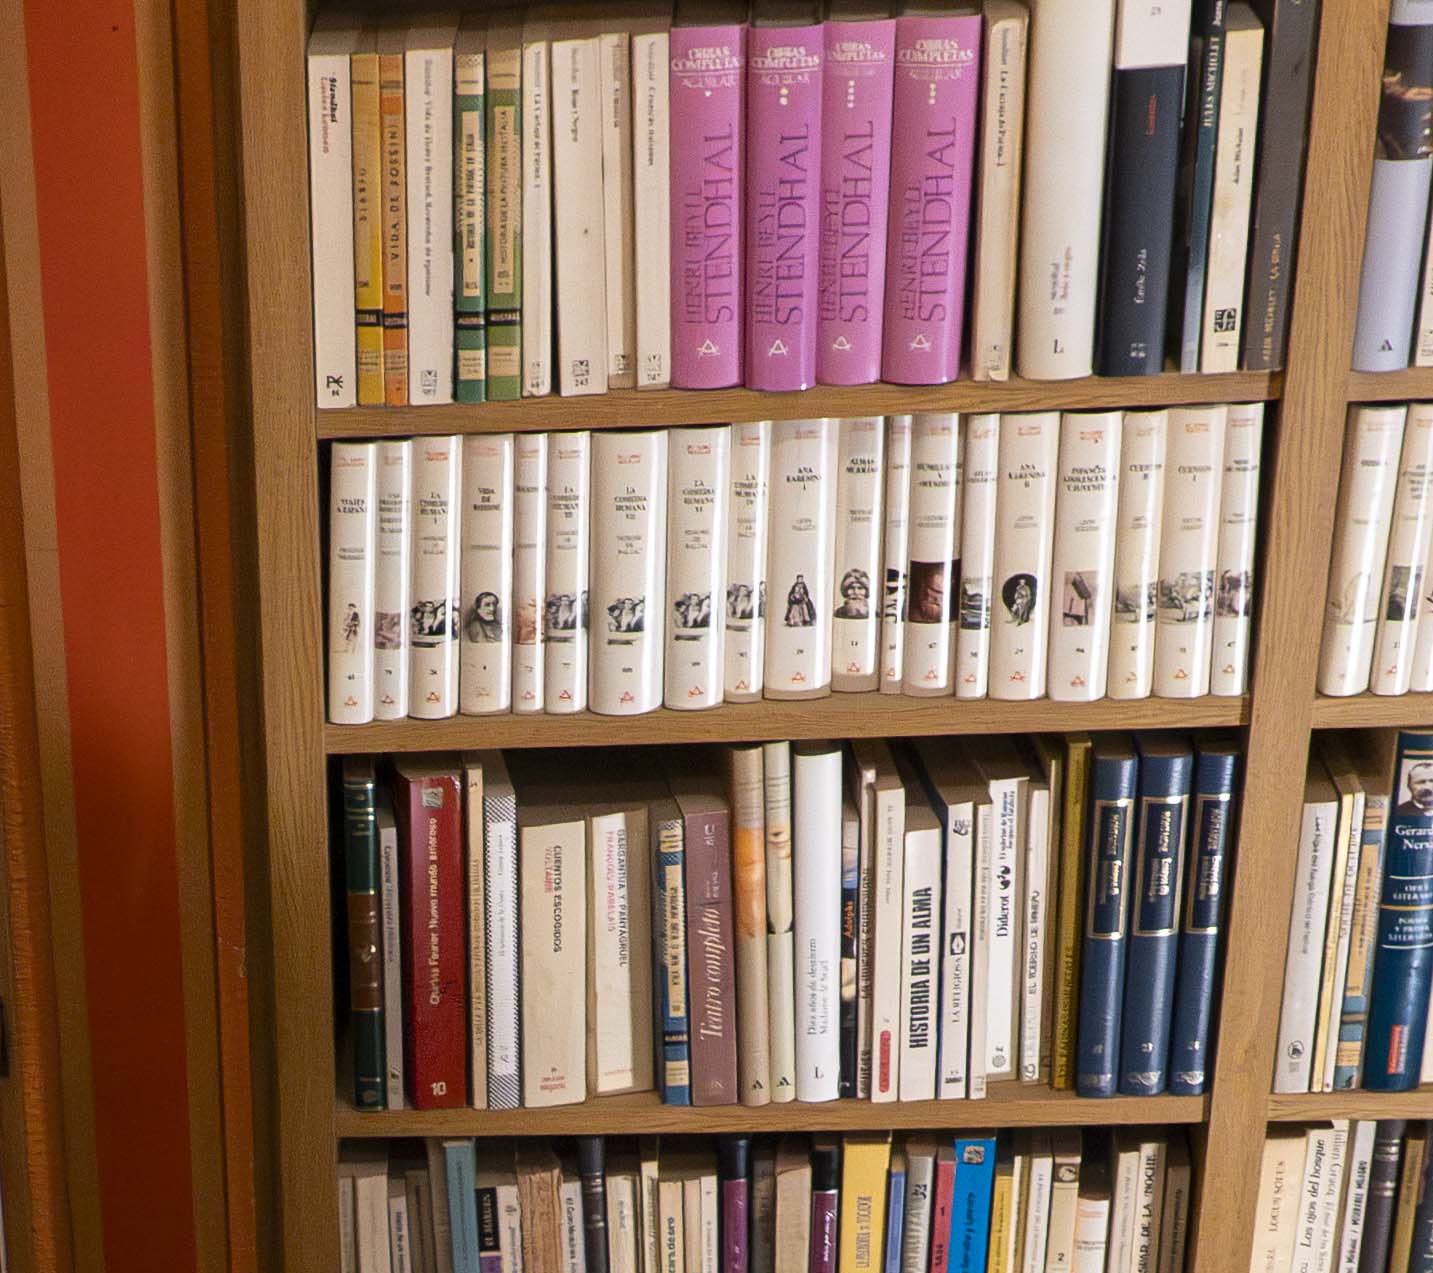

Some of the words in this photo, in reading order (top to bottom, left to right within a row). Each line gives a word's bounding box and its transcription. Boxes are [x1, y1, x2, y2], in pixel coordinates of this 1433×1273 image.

[703, 123, 733, 325] STENDHAL
[775, 123, 809, 325] STENDHAL
[839, 120, 874, 323] STENDHAL
[918, 117, 957, 321] STENDHAL
[684, 259, 703, 324] HENRI
[755, 261, 774, 325] HENRI
[822, 258, 840, 321] HENRI
[901, 251, 918, 320] HENRI
[552, 845, 562, 892] CUENTOS
[552, 895, 562, 953] ESCOGIDOS
[912, 887, 932, 929] ALMA
[995, 895, 1010, 937] Diderot
[701, 908, 726, 982] completo
[910, 958, 931, 976] DE
[911, 933, 931, 954] UN
[699, 986, 723, 1040] Teatro
[909, 980, 931, 1048] HISTORIA
[431, 1082, 446, 1096] 10
[1309, 1139, 1326, 1178] bosque
[1141, 1203, 1152, 1217] LA
[1304, 1200, 1319, 1224] ojos
[1306, 1180, 1320, 1197] del
[1140, 1221, 1150, 1237] DE
[1299, 1227, 1313, 1247] Los
